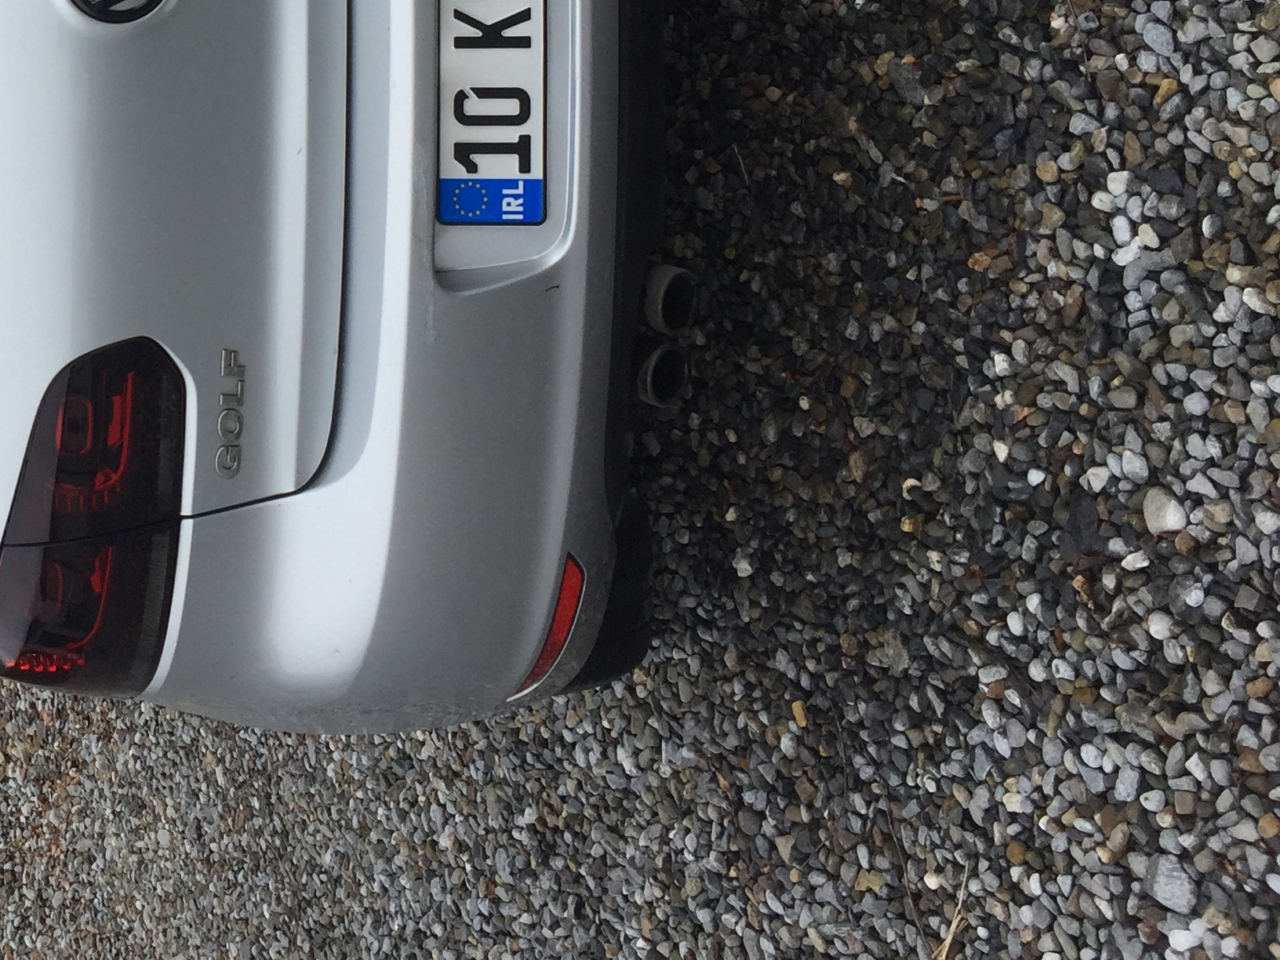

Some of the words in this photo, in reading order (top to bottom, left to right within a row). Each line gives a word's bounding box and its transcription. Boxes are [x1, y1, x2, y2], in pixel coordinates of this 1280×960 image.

[452, 86, 532, 175] 10
[501, 180, 524, 220] IRL
[214, 348, 246, 480] GOLF
